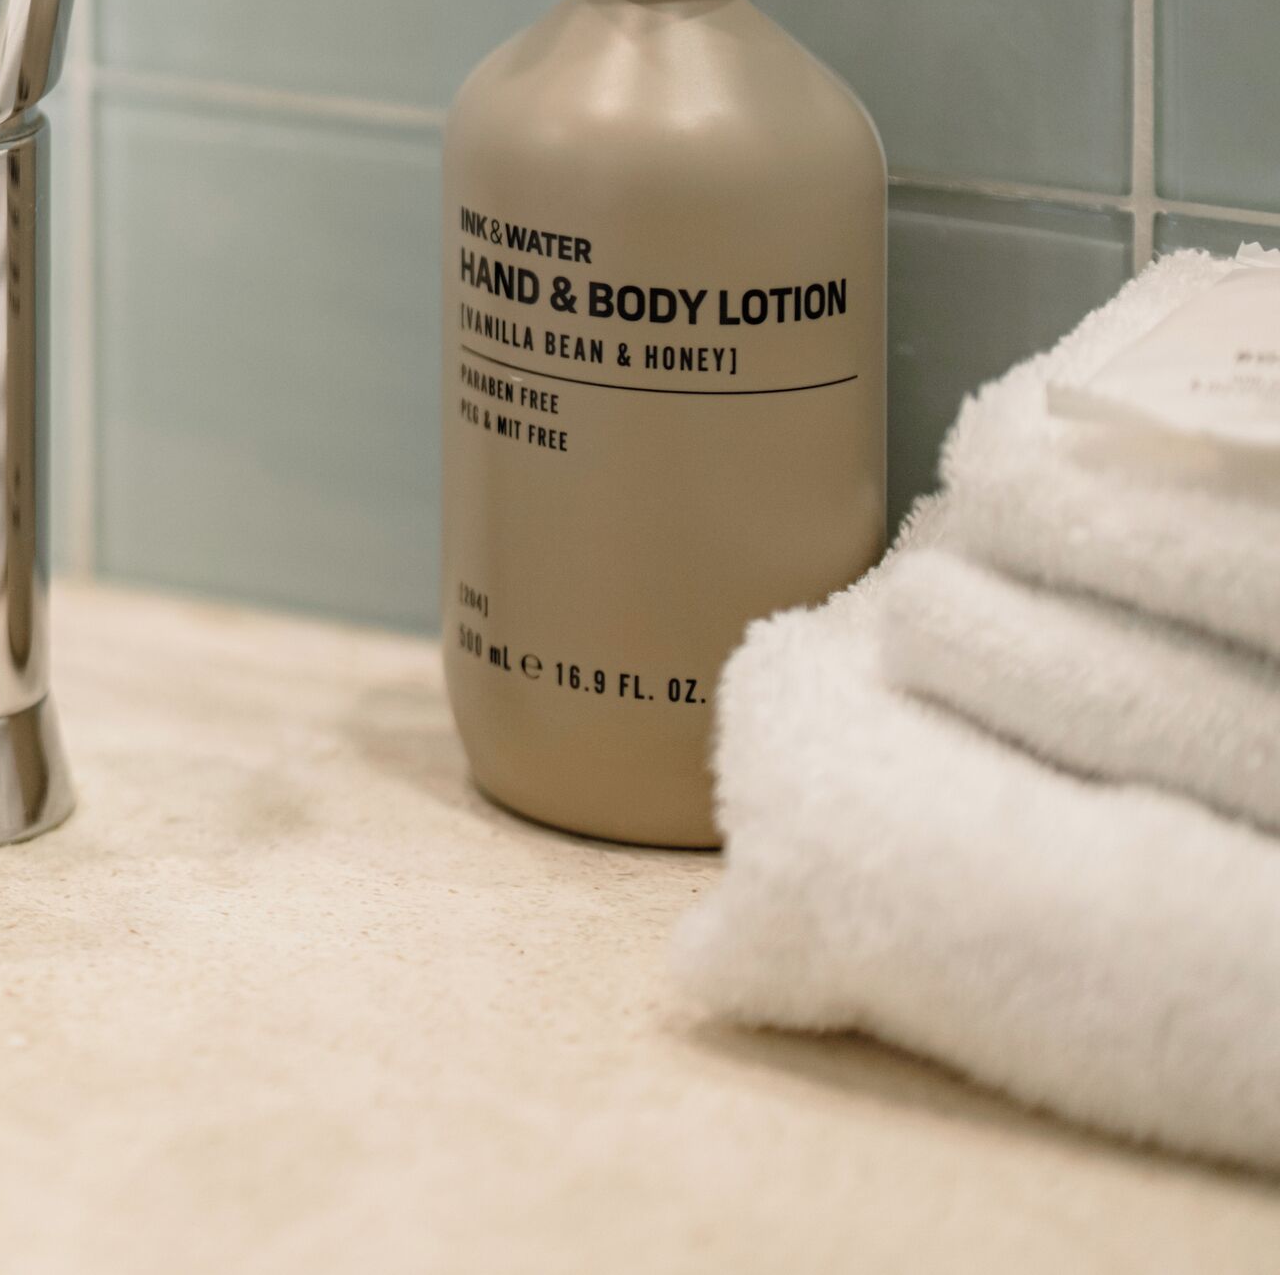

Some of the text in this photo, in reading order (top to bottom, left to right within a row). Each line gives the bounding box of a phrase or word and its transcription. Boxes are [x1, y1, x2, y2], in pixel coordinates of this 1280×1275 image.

[461, 247, 846, 325] HAND & BODY LOTION
[461, 303, 737, 375] [VANILLA BEAN & HONEY]
[461, 364, 559, 414] PARABEN FREE
[461, 398, 568, 452] PEG & MIT FREE
[459, 623, 482, 658] 500
[556, 662, 605, 694] 16.9
[619, 673, 654, 700] FL.
[668, 678, 706, 703] OZ.
